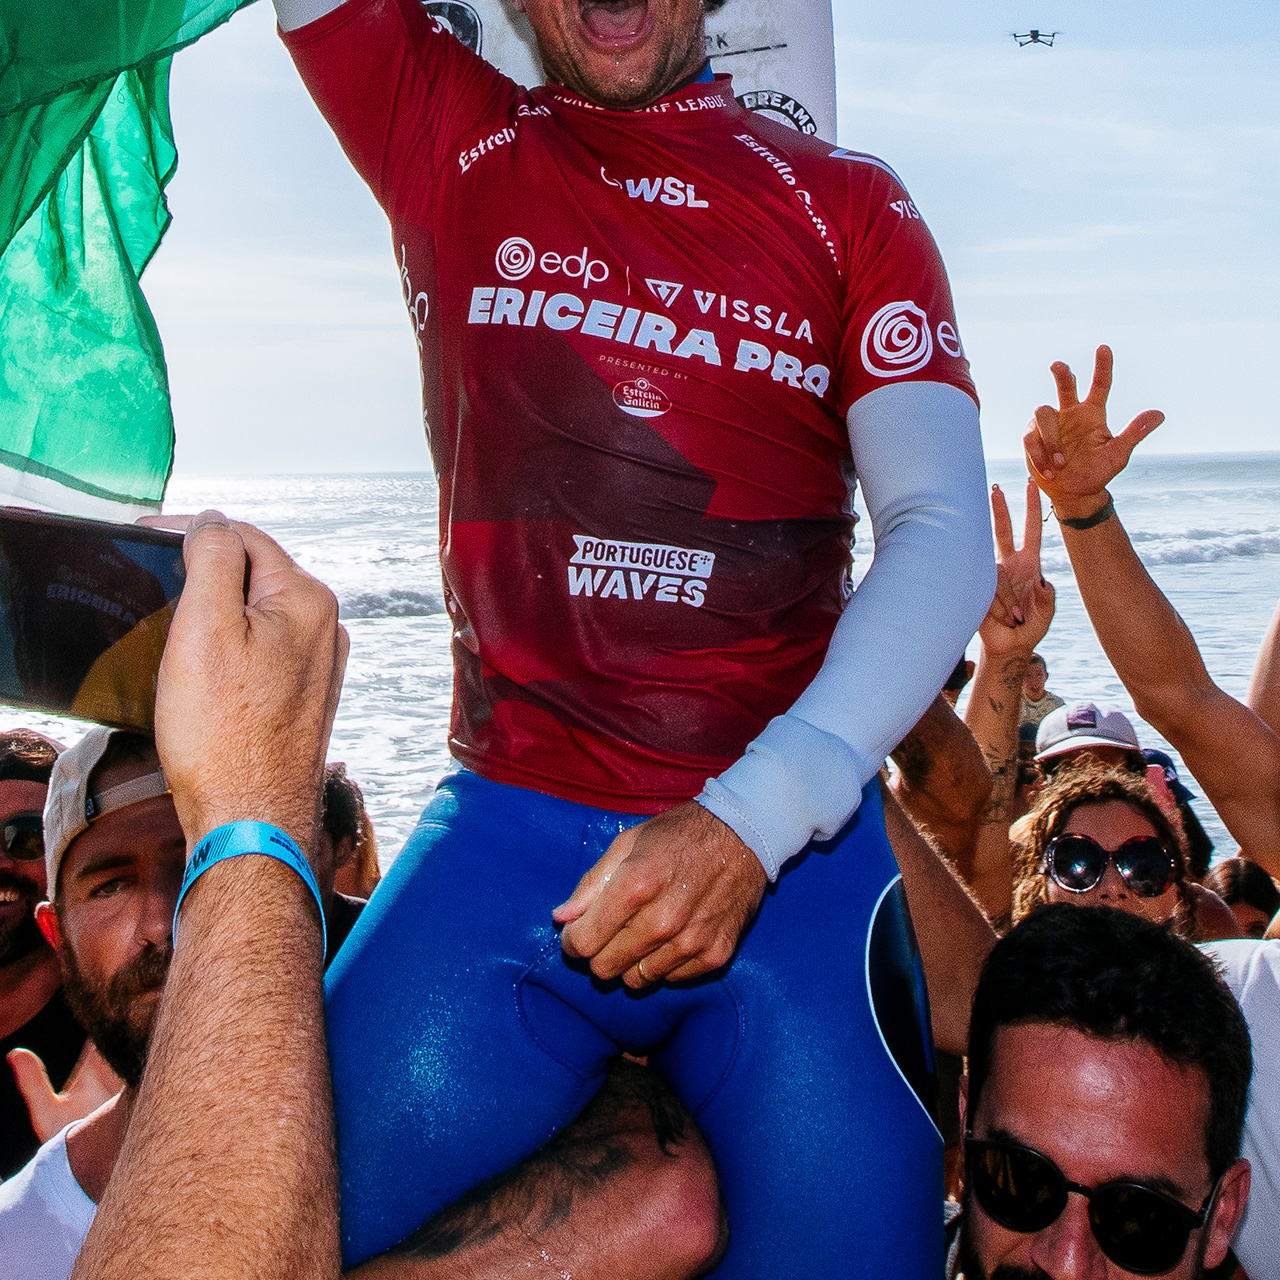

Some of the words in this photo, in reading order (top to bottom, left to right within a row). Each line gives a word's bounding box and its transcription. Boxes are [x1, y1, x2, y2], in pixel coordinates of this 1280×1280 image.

[676, 94, 728, 113] LEAGUE
[743, 91, 815, 135] DREAMS
[625, 177, 709, 209] WSL
[539, 247, 609, 289] edp
[693, 289, 814, 344] VISSLA
[467, 286, 722, 366] ERICEIRA
[733, 339, 831, 398] PRO
[599, 355, 669, 376] PRESENTED
[674, 372, 690, 381] BY
[623, 395, 660, 410] Galicia
[581, 540, 700, 572] PORTUGUESE
[567, 566, 708, 608] WAVES
